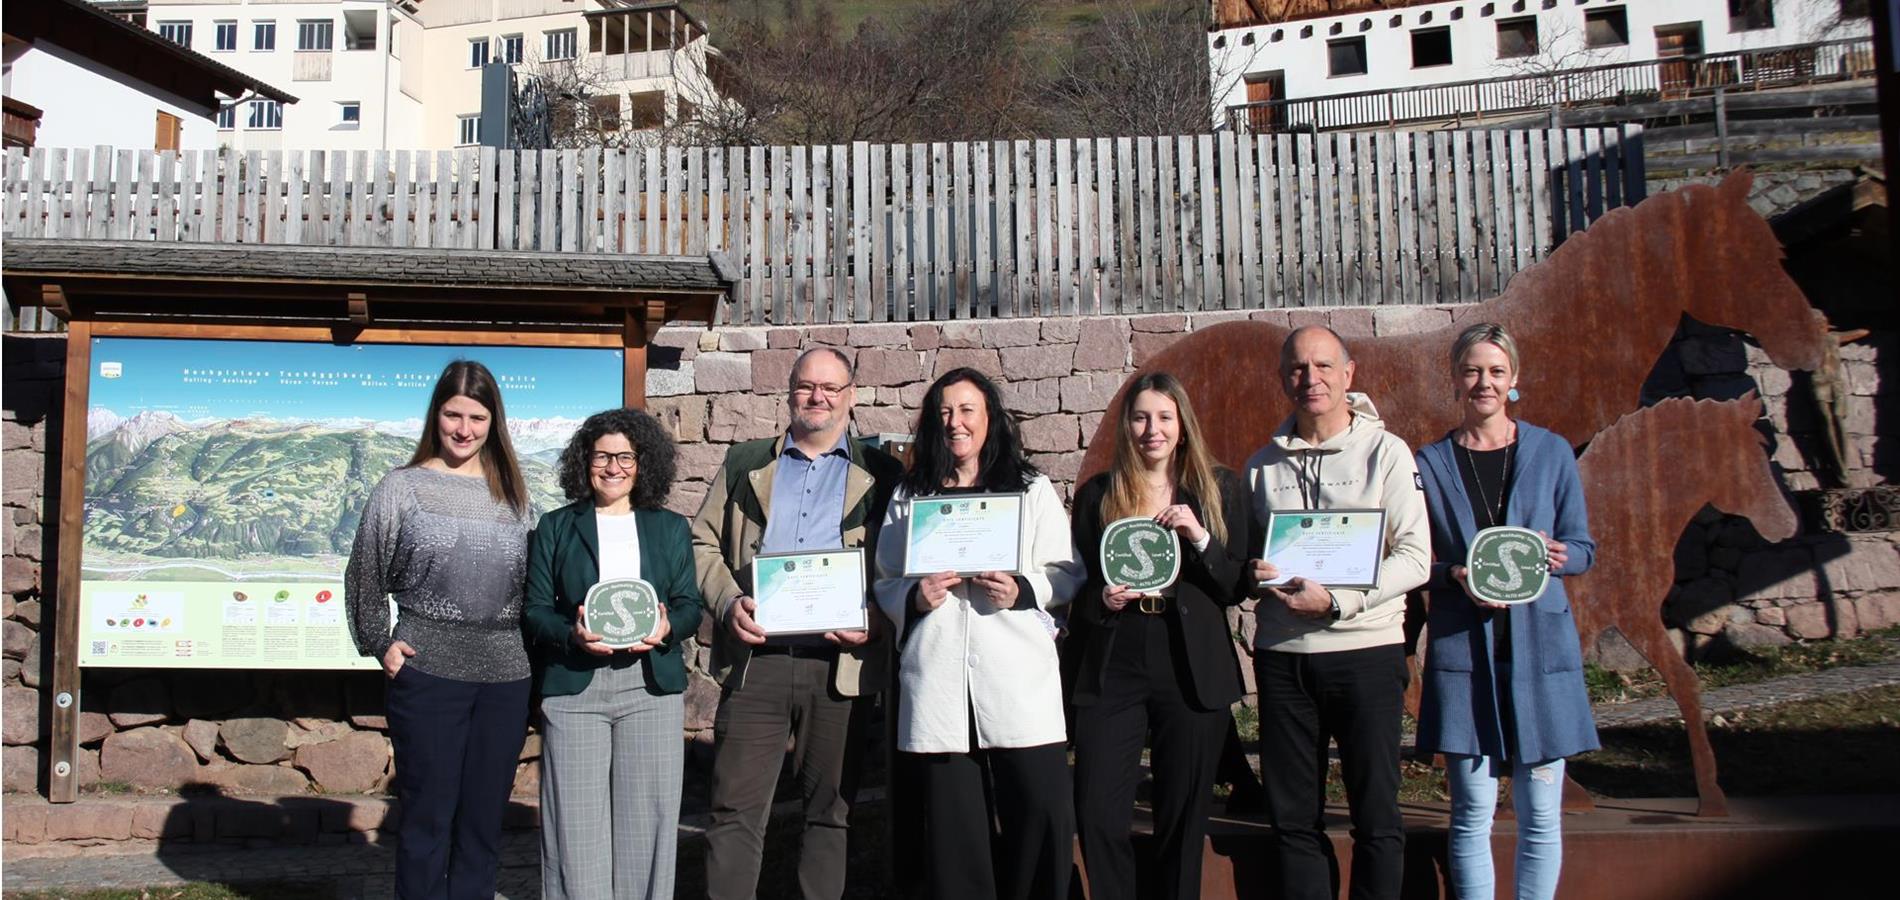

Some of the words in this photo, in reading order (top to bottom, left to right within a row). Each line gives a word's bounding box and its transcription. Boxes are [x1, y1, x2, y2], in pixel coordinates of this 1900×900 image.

[1120, 530, 1160, 580] S
[1486, 540, 1532, 592] S
[603, 590, 640, 636] S
